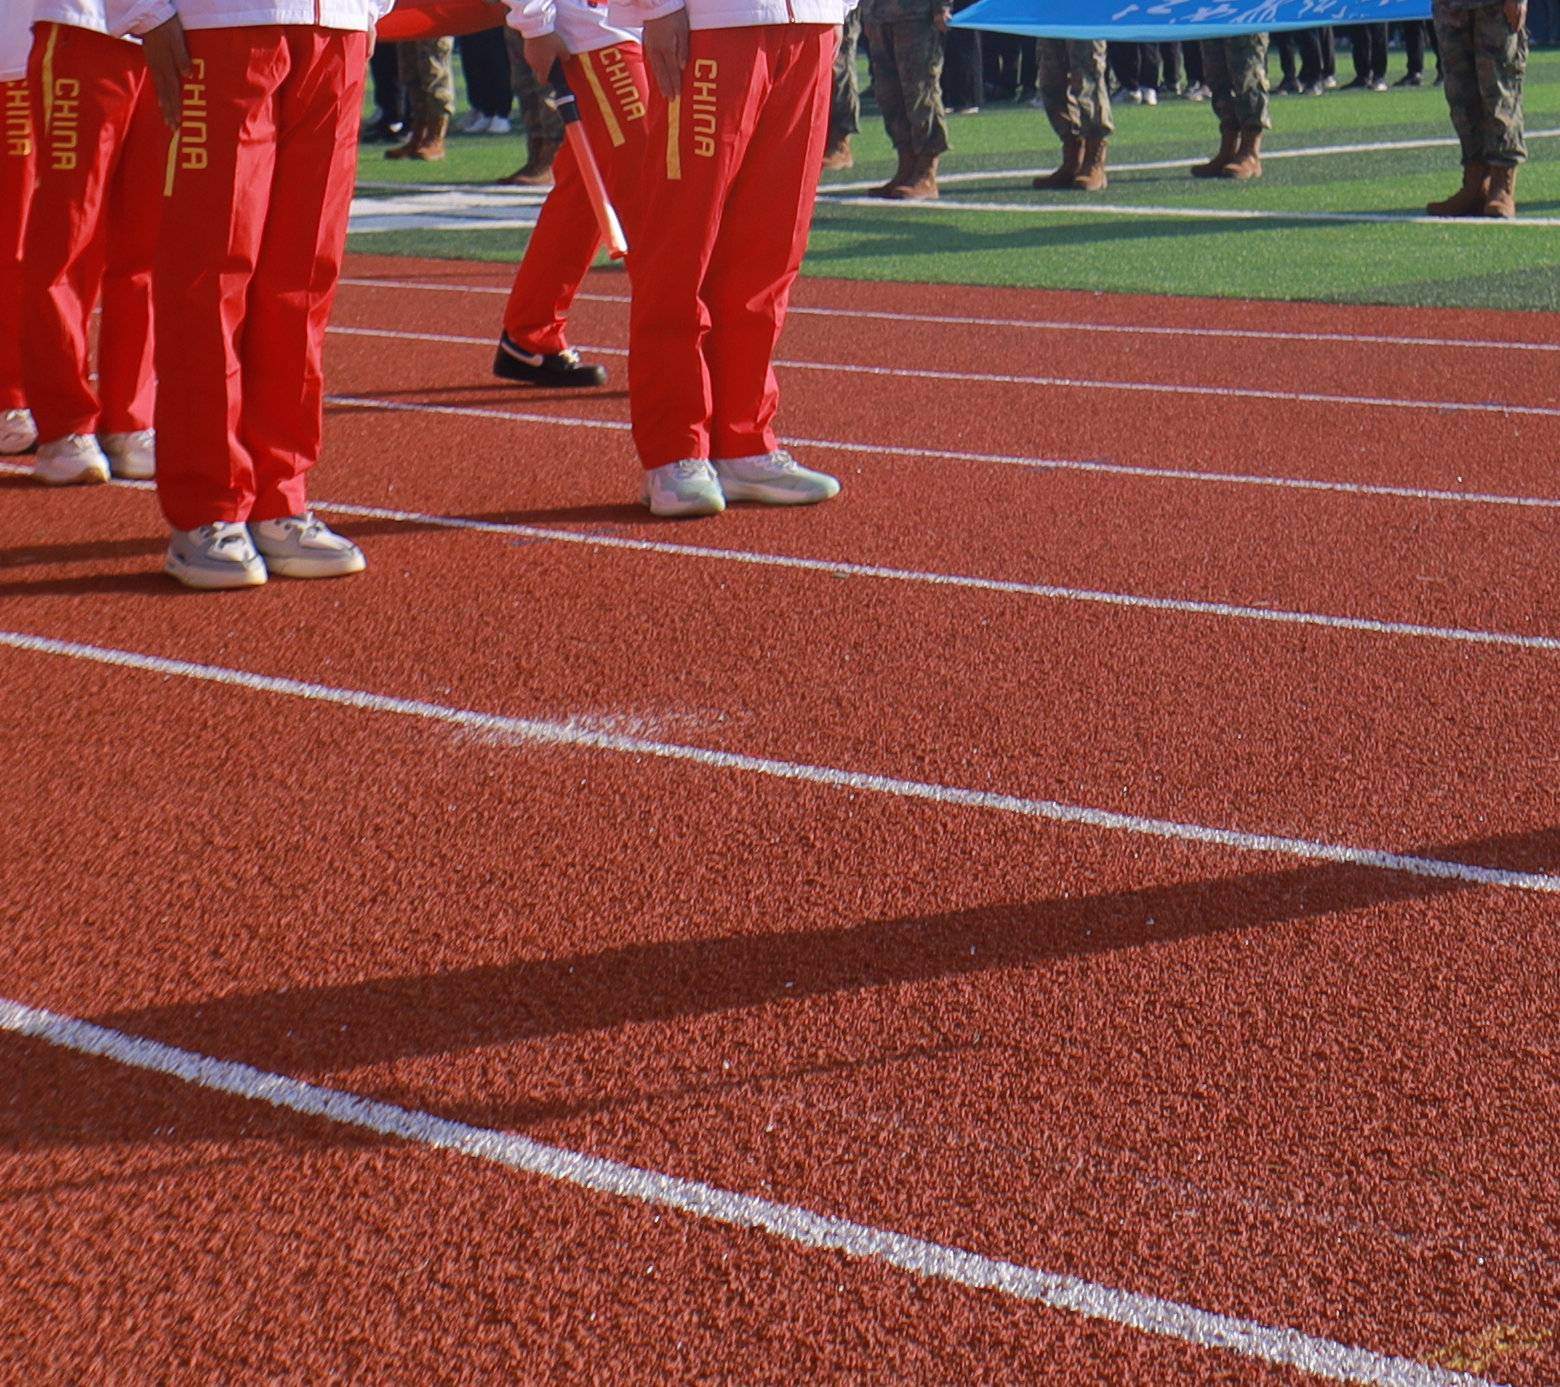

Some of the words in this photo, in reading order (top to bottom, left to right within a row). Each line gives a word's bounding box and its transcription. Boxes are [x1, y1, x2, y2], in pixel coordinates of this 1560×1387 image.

[51, 78, 80, 170] CHINA
[599, 46, 646, 122] CHINA
[693, 58, 718, 158] CHINA
